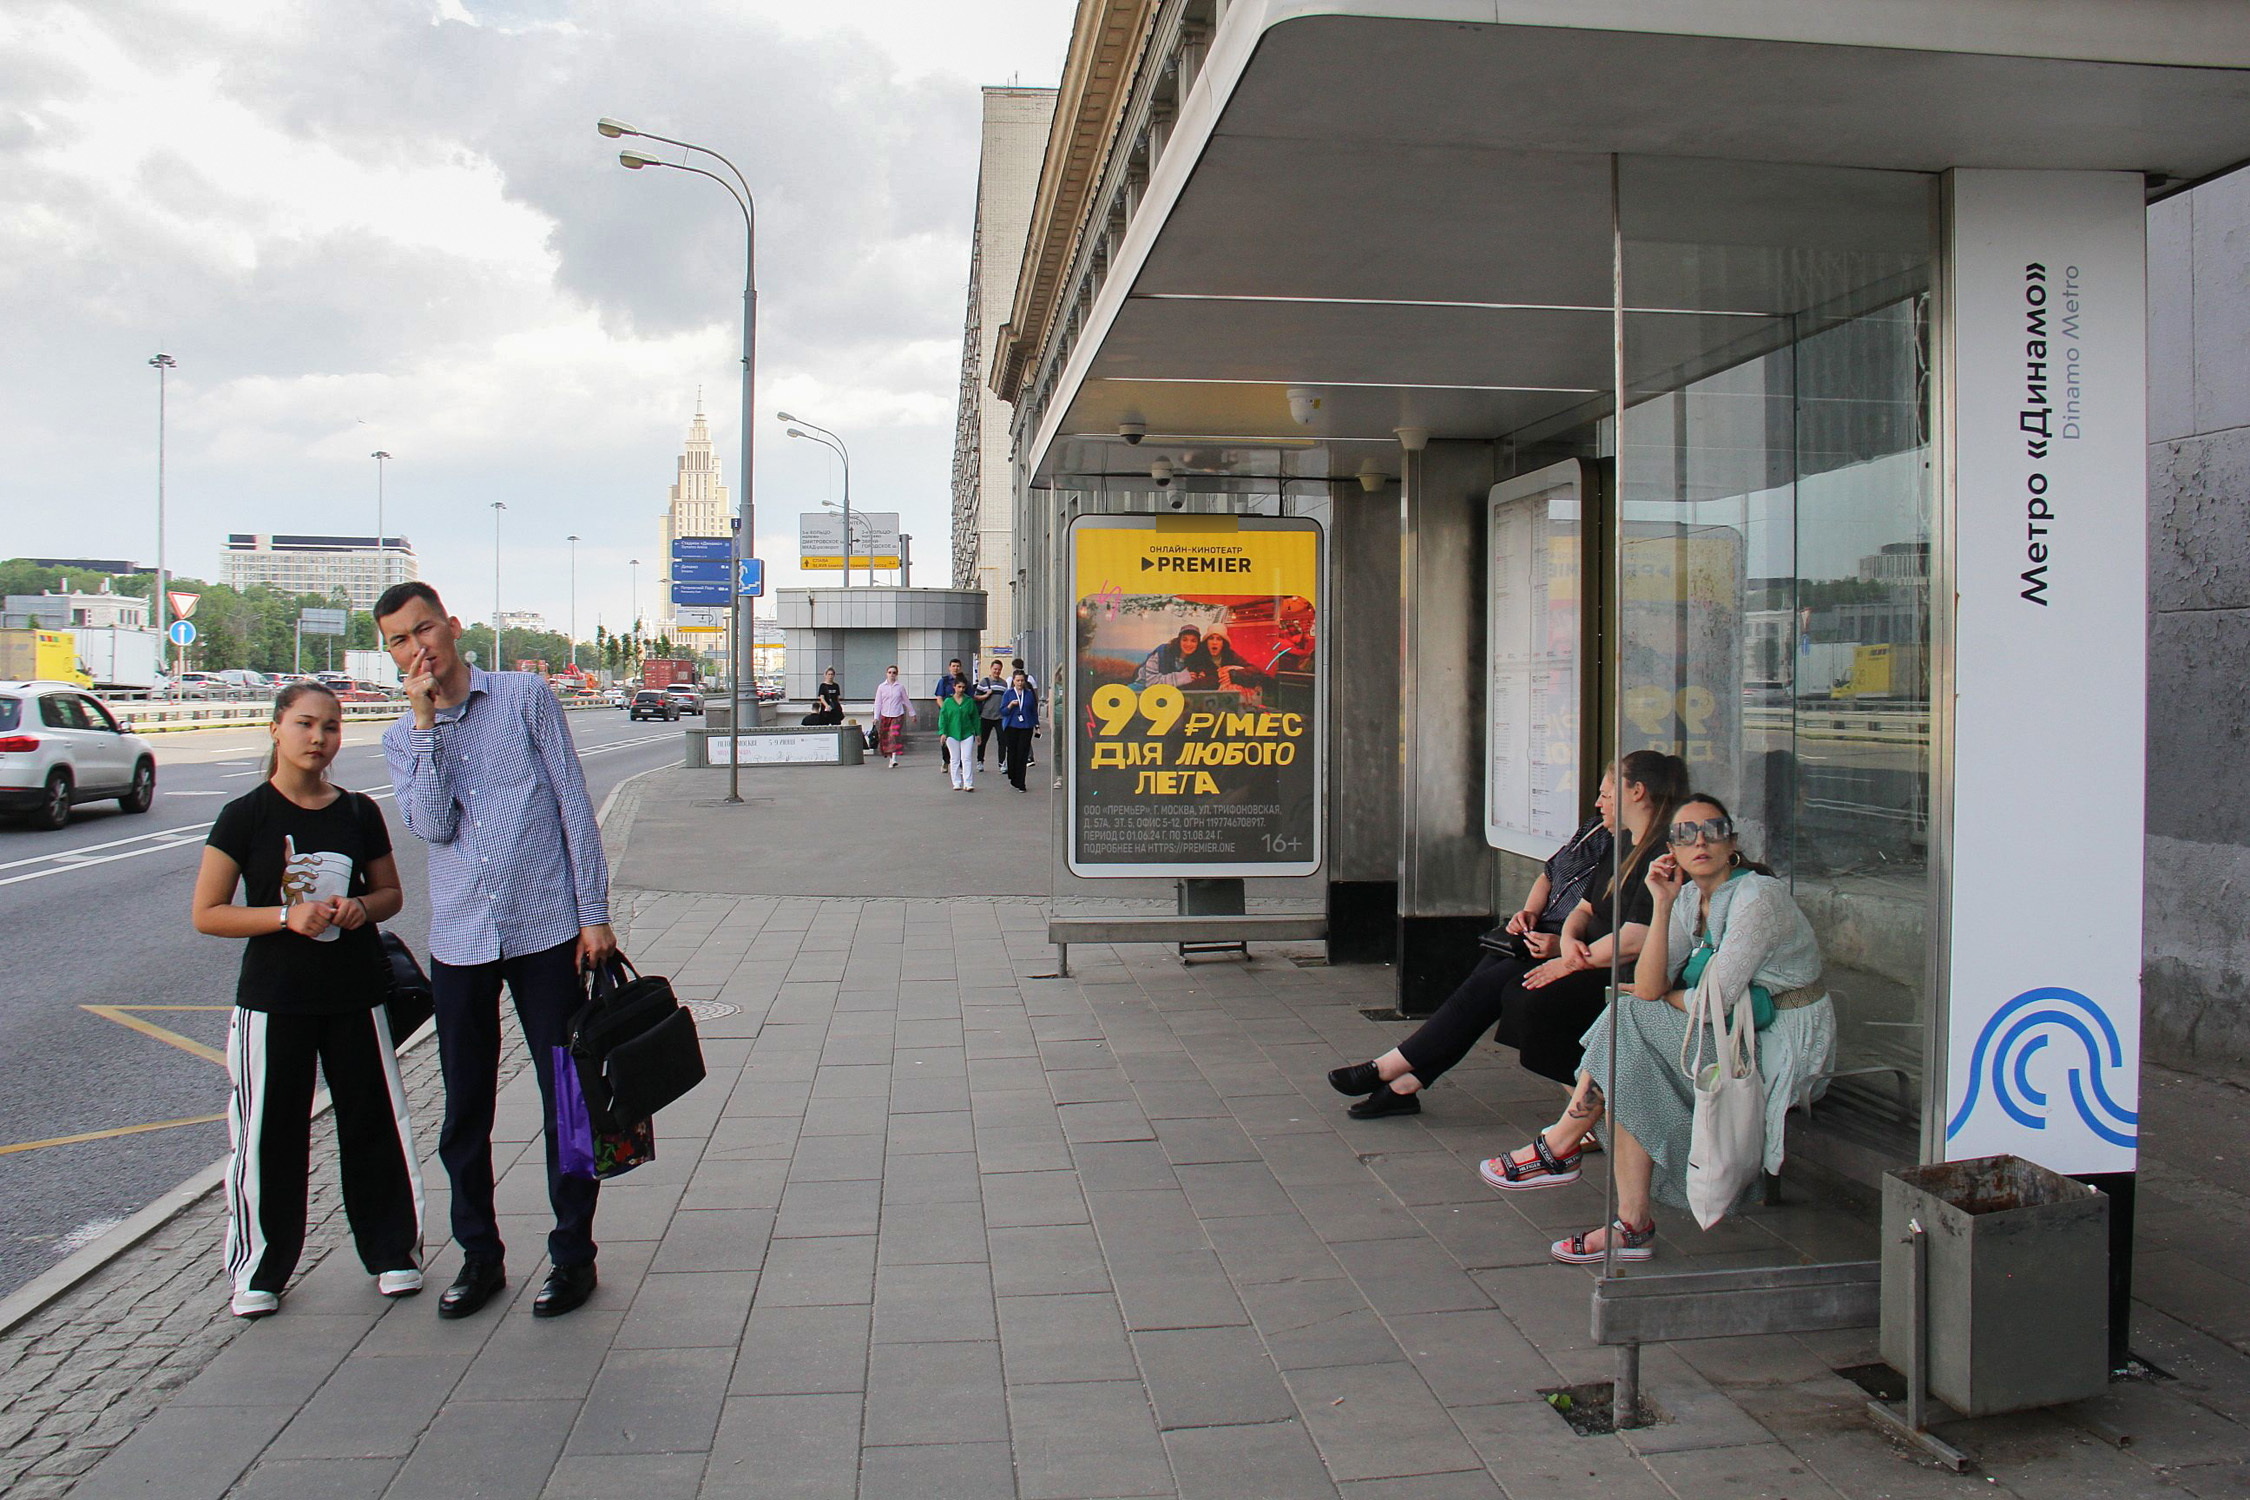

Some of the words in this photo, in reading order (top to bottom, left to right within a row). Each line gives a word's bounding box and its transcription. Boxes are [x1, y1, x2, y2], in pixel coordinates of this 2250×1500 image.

[2062, 265, 2080, 339] Metro
[2020, 262, 2052, 459] «Динамо»
[2062, 347, 2080, 440] Dinamo
[1149, 545, 1243, 554] ОНЛАЙН-КИНОТЕАТР
[2020, 473, 2054, 607] Метро
[1157, 556, 1252, 573] PREMIER
[1091, 683, 1185, 736] 99
[1184, 711, 1304, 739] ₽/МЕС
[1091, 742, 1163, 770] ДЛЯ
[1175, 741, 1296, 766] ЛЮБОГО
[1134, 771, 1221, 795] ЛЕТА
[1083, 804, 1101, 816] ООО
[1136, 817, 1161, 828] ОФИС
[1183, 817, 1205, 828] ОГРН
[1083, 830, 1118, 842] ПЕРИОД
[1119, 831, 1125, 840] С
[1126, 830, 1160, 840] 01.06.24
[1169, 830, 1182, 840] ПО
[1260, 832, 1303, 853] 16+
[1083, 843, 1133, 855] ПОДРОБНЕЕ
[1134, 843, 1147, 853] НА
